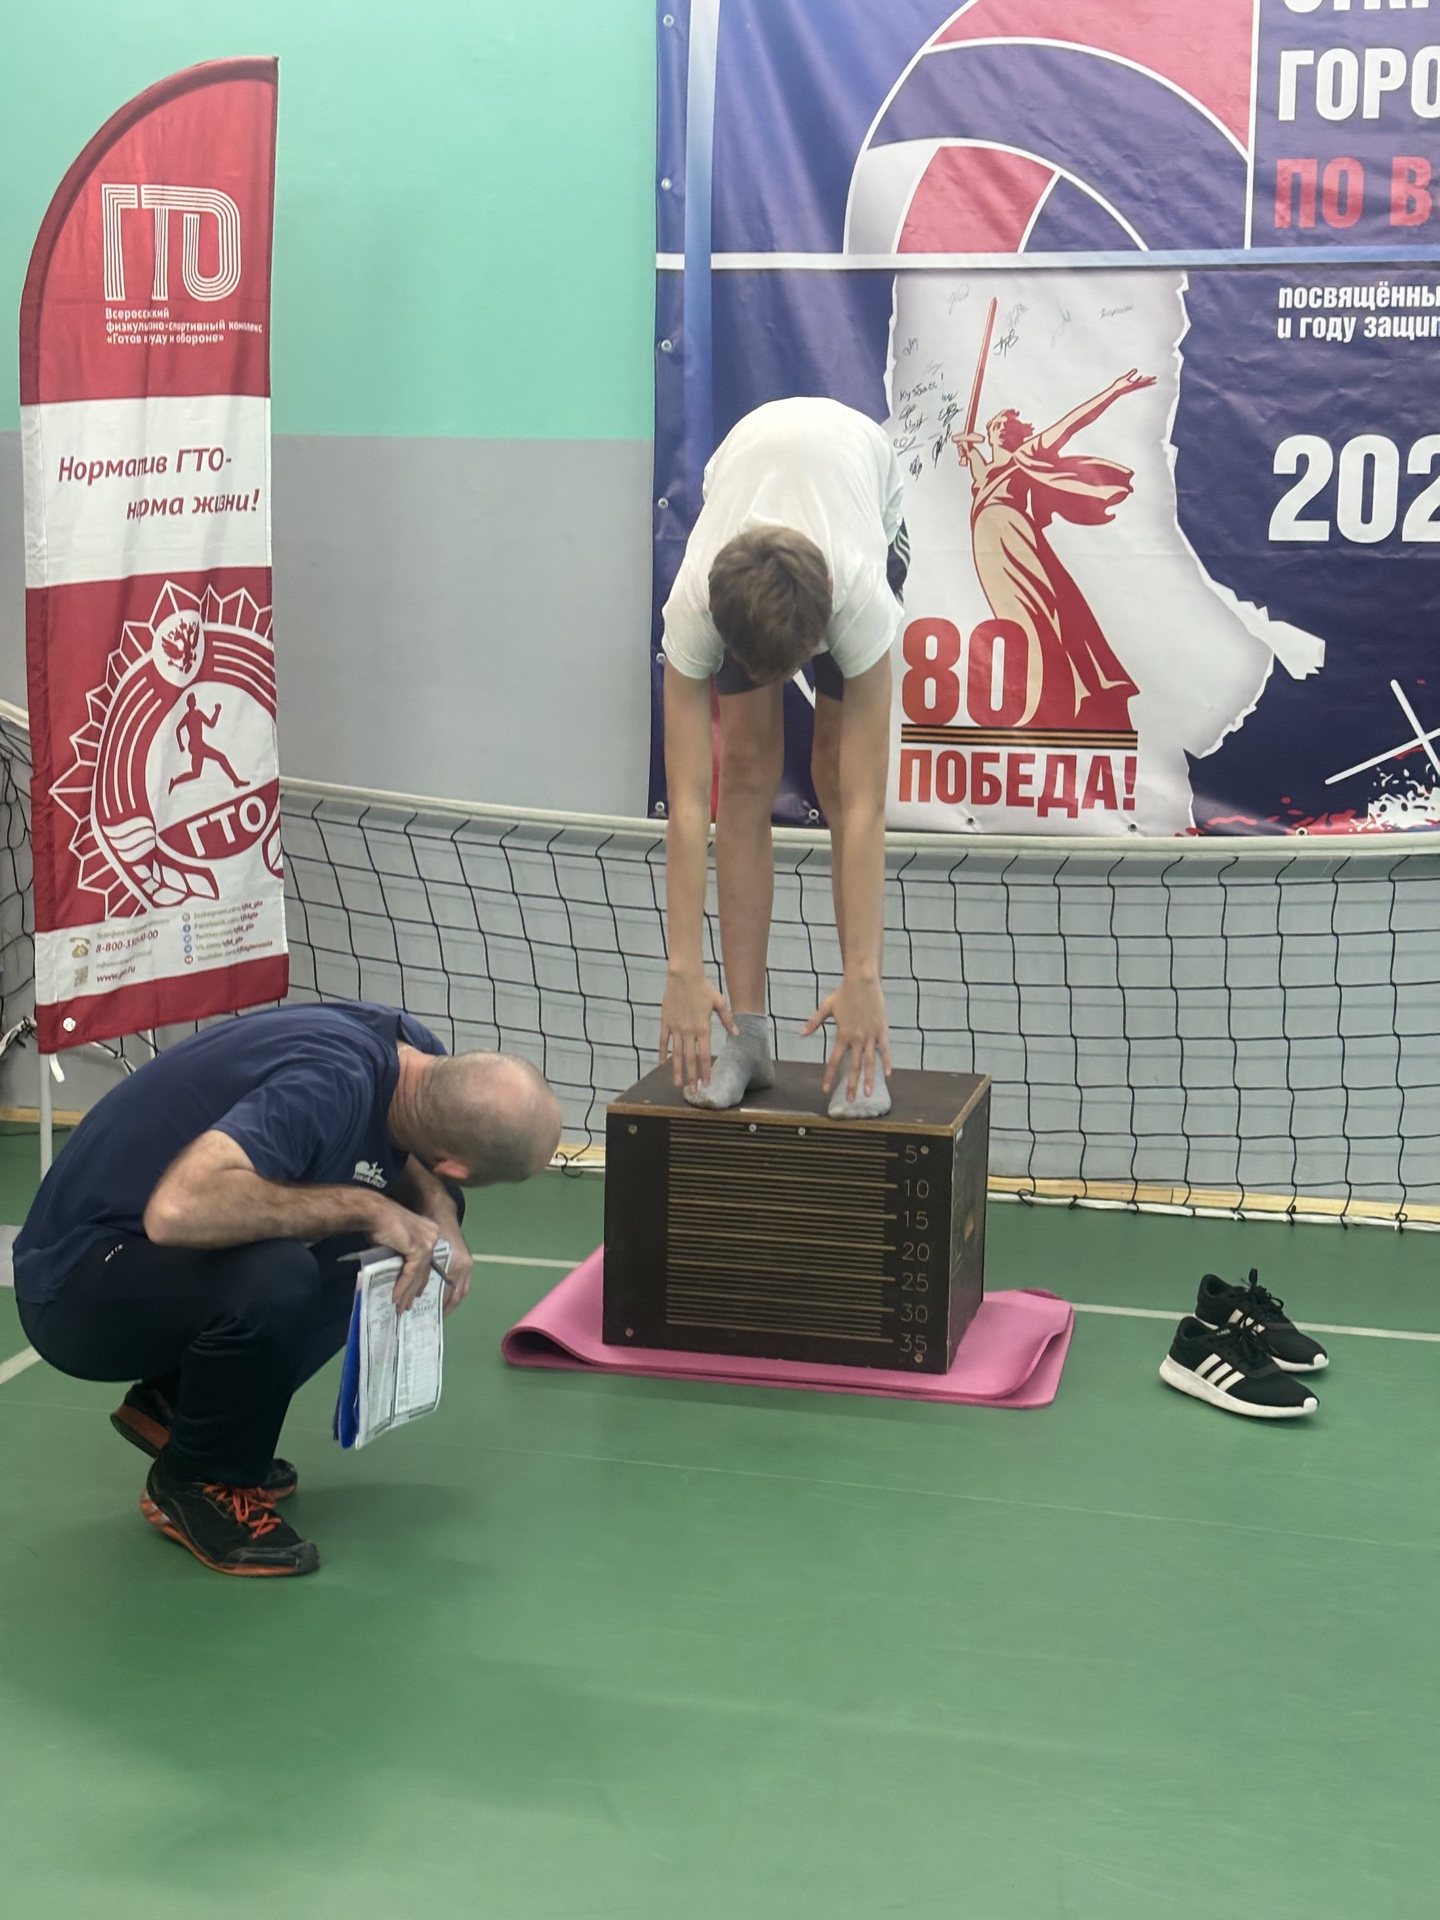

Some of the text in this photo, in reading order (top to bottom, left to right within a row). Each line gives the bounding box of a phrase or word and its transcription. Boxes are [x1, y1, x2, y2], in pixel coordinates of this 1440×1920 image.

[1278, 45, 1440, 121] ГОРО
[1274, 156, 1364, 229] ПО
[102, 182, 241, 302] ГТО
[1278, 281, 1440, 310] посвящённы
[1277, 317, 1292, 339] и
[1299, 316, 1357, 343] году
[1268, 434, 1440, 543] 202
[902, 617, 1029, 728] 80
[899, 749, 1138, 819] ПОБЕДА!
[186, 796, 267, 858] ГТО
[904, 1145, 918, 1164] 5
[903, 1179, 930, 1199] 10
[903, 1211, 929, 1230] 15
[902, 1242, 930, 1262] 20
[901, 1273, 929, 1292] 25
[900, 1303, 928, 1324] 30
[900, 1333, 927, 1353] 35
